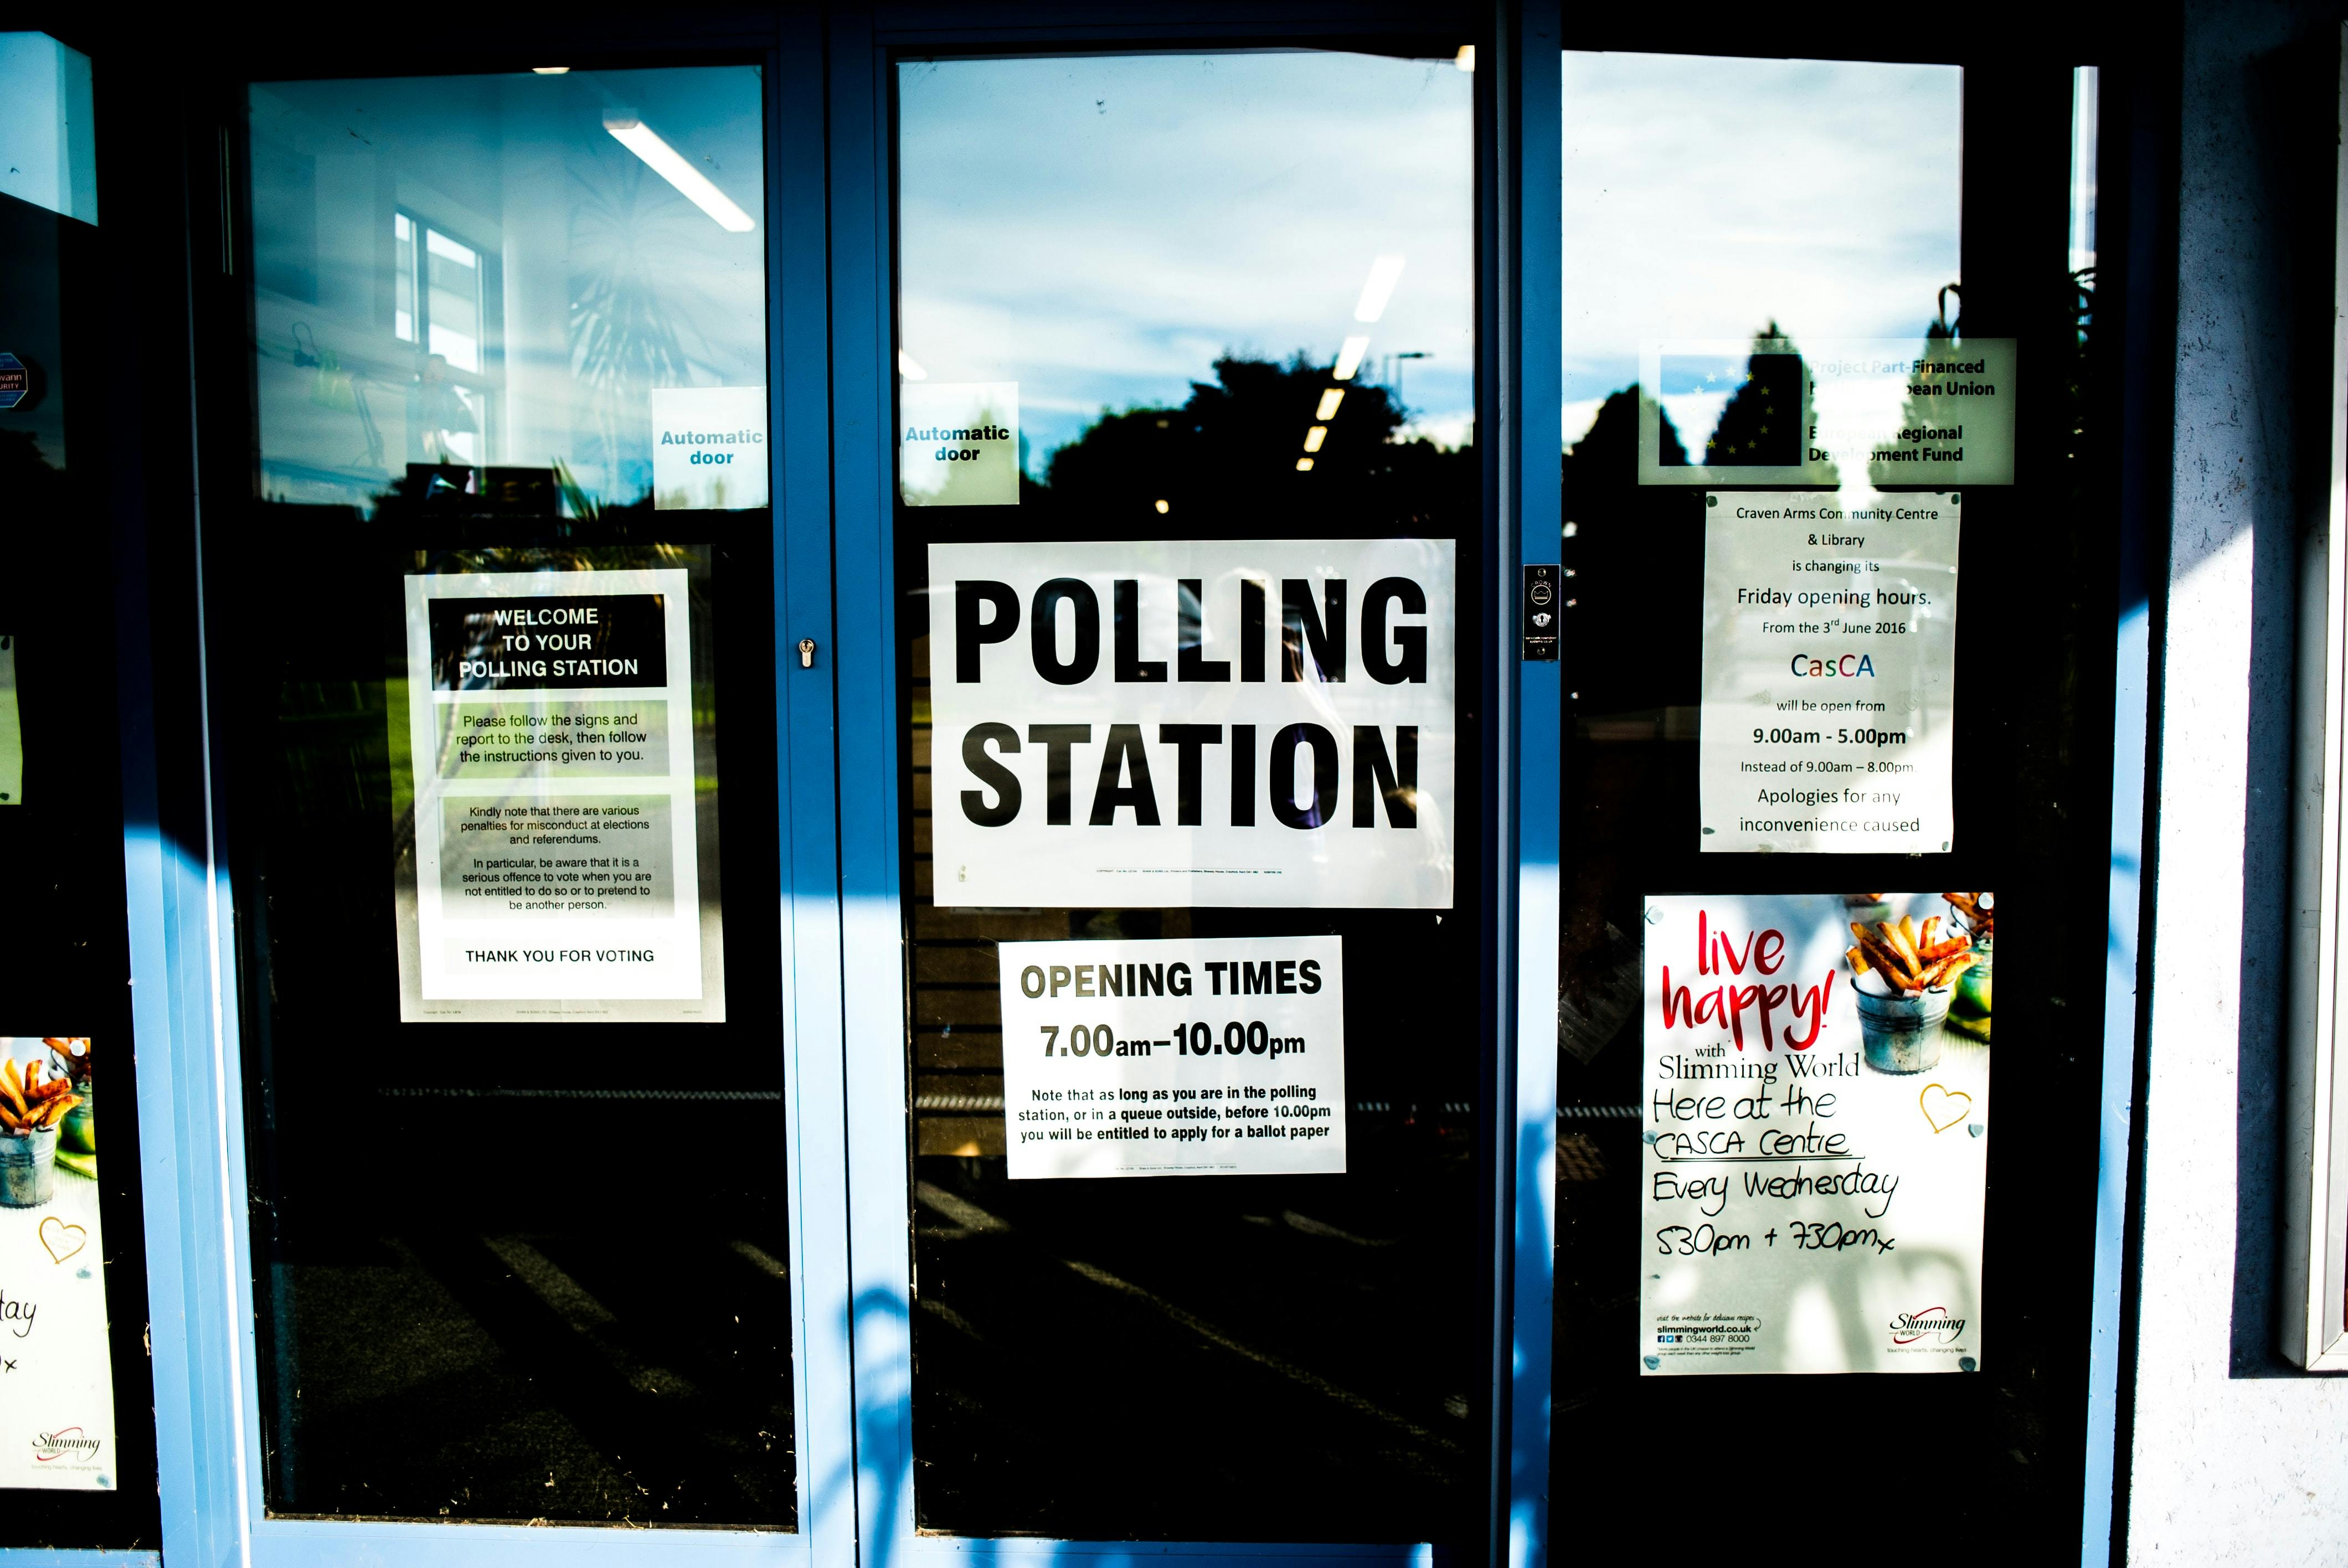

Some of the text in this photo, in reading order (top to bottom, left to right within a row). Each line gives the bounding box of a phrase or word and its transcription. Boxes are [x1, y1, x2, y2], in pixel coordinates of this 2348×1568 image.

[1872, 359, 1985, 373] Part-Financed
[1947, 381, 1995, 395] Union
[661, 430, 763, 445] Automatic
[907, 425, 1009, 440] Automatic
[691, 451, 733, 465] door
[936, 447, 980, 461] door
[1923, 447, 1963, 461] Fund
[1737, 508, 1779, 519] Craven
[1784, 508, 1816, 519] Arms
[1896, 509, 1938, 519] Centre
[1808, 534, 1865, 548] & Library
[1793, 560, 1879, 574] is changing its
[1738, 588, 1931, 607] Friday opening hours.
[495, 608, 599, 626] WELCOME
[956, 576, 1427, 685] POLLING
[1763, 622, 1794, 633] From
[1799, 622, 1819, 633] the
[1843, 623, 1871, 633] June
[1875, 623, 1906, 634] 2016
[502, 635, 591, 651] TO YOUR
[460, 659, 638, 678] POLLING STATION
[1791, 654, 1875, 678] CasCA
[1777, 700, 1884, 713] will be open from
[464, 713, 637, 728] Please follow the signs and
[457, 731, 647, 748] report to the desk, then follow
[1754, 729, 1820, 743] 9.00am
[1839, 729, 1906, 747] 5.00pm
[460, 749, 643, 764] the instructions given to you.
[1741, 762, 1786, 772] Instead
[1790, 761, 1803, 772] of
[1806, 762, 1852, 772] 9.00am
[960, 722, 1419, 830] STATION
[1758, 788, 1901, 805] Apologies for any
[470, 807, 501, 818] Kindly
[505, 807, 527, 816] note
[531, 807, 550, 816] that
[553, 806, 579, 816] there
[602, 806, 639, 815] various
[461, 820, 649, 833] penalties for misconduct at elections
[1741, 817, 1919, 832] inconvenience caused
[1698, 910, 1785, 976] live
[466, 950, 653, 962] THANK YOU FOR VOTING
[1021, 960, 1322, 998] OPENING TIMES
[1662, 966, 1835, 1052] happy!
[1695, 1043, 1725, 1057] with
[1659, 1053, 1859, 1083] Slimming World
[1032, 1085, 1316, 1103] Note that as long as you are in the polling
[1654, 1084, 1836, 1122] Here at the
[1019, 1105, 1330, 1123] station, or in a queue outside, before 10.00pm
[1021, 1125, 1329, 1143] you will be entitled to apply for a ballot paper
[1654, 1121, 1850, 1159] CASCA Centre
[1654, 1163, 1899, 1218] Every Wednesday
[1765, 1229, 1777, 1247] +
[1737, 1315, 1754, 1324] recipes
[1657, 1325, 1751, 1334] slimmingworld.co.uk
[1890, 1313, 1965, 1344] Slimming
[33, 1432, 100, 1462] Slimming
